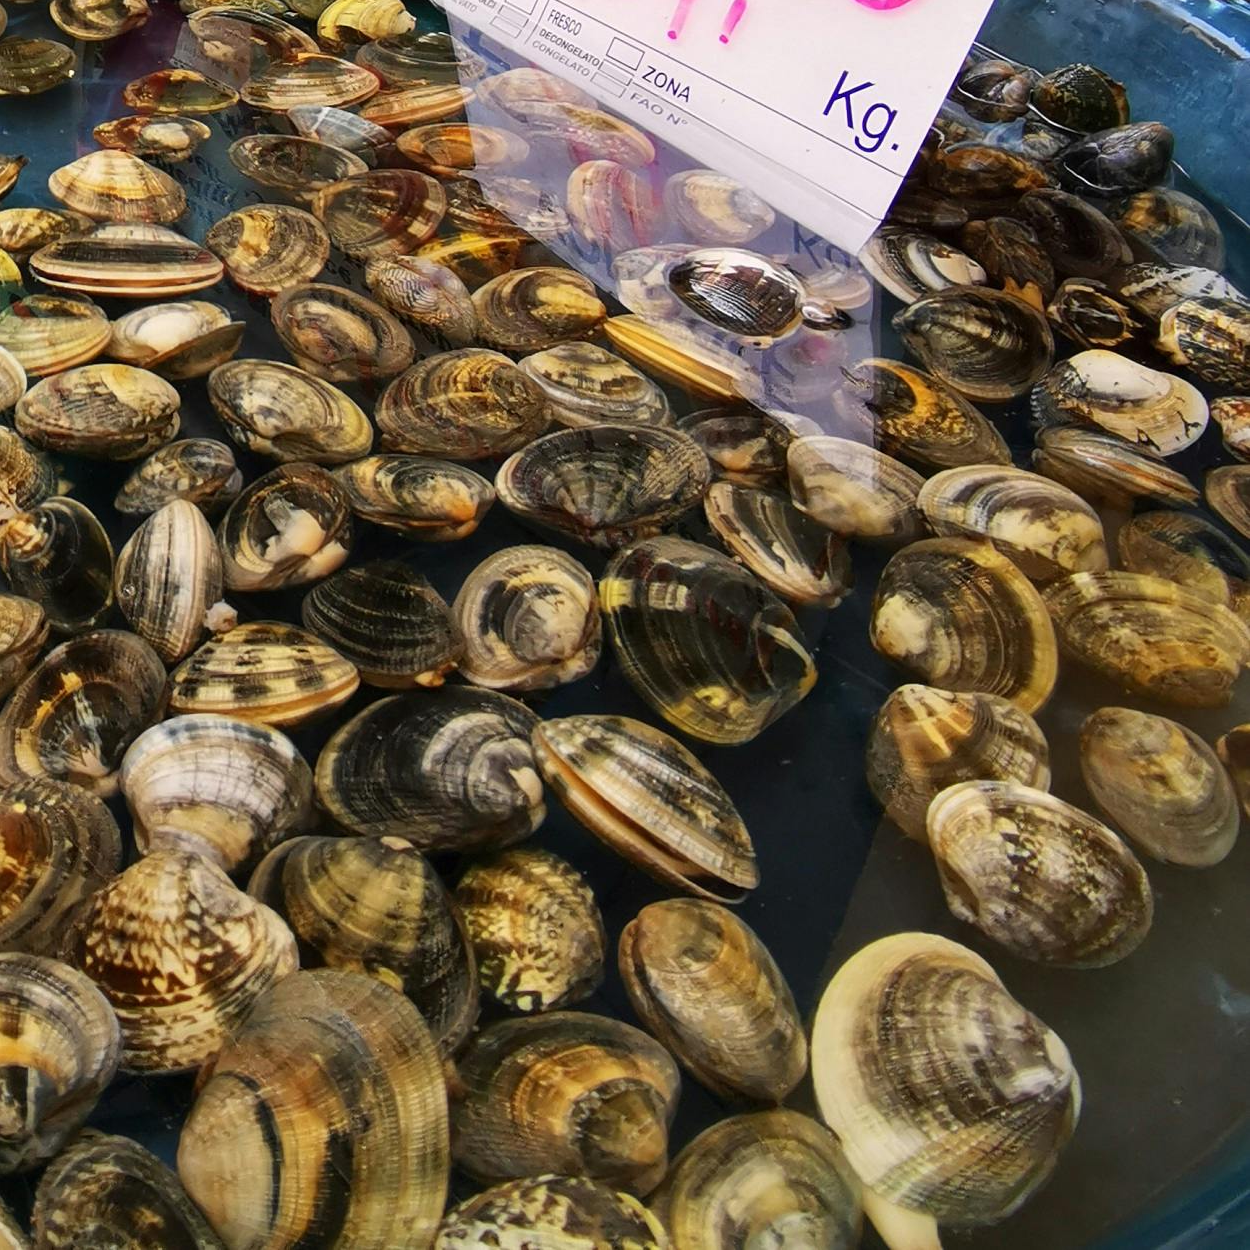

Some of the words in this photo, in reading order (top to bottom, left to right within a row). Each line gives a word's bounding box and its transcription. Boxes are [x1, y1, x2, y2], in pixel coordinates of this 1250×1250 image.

[548, 9, 582, 36] FRESCO
[532, 40, 591, 77] CONGELATO
[539, 28, 600, 67] DECONGELATO
[641, 65, 691, 103] ZONA
[630, 92, 664, 116] FAO
[823, 69, 899, 152] Kg.
